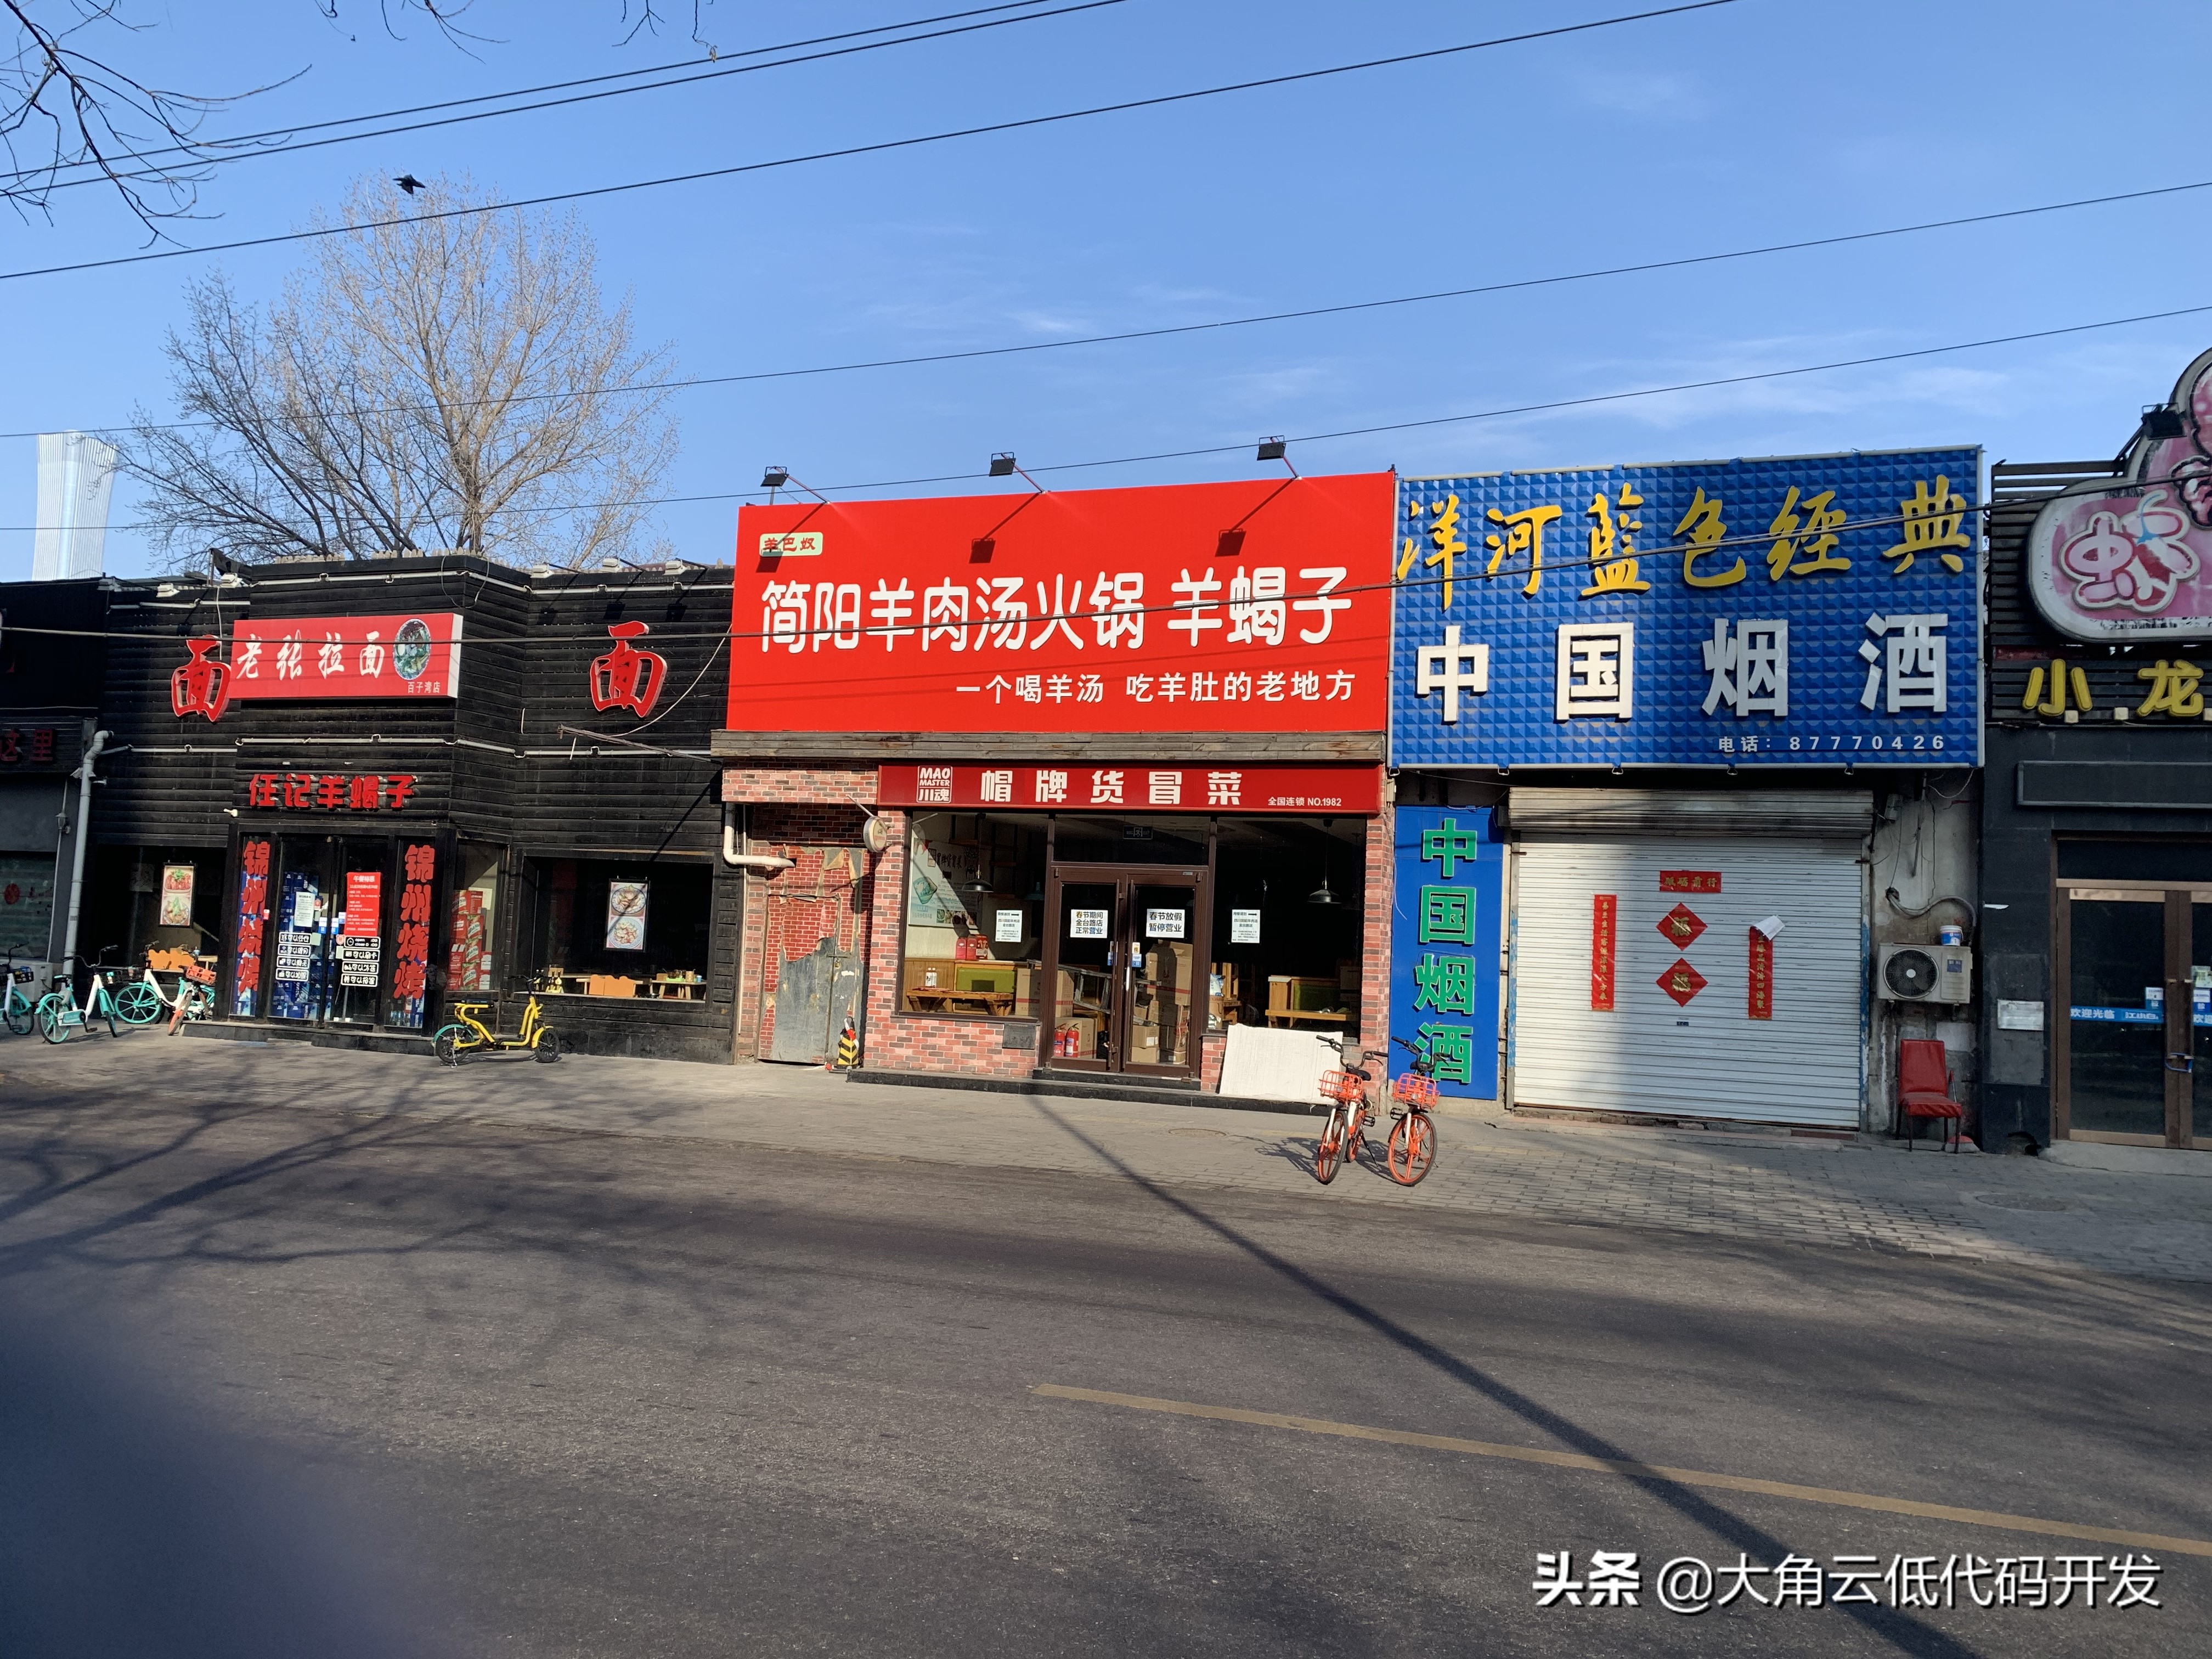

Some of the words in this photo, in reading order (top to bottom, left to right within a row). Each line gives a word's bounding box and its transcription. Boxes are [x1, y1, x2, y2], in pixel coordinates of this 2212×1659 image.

[760, 571, 1144, 654] 简阳羊肉汤火锅
[1167, 565, 1352, 647] 羊蝎子
[236, 629, 385, 681] 老张拉面
[1416, 612, 1948, 724] 中国烟酒
[407, 681, 441, 694] 百子湾店
[956, 673, 1104, 704] 一个喝羊汤
[1126, 669, 1356, 703] 吃羊肚的老地方
[2023, 658, 2204, 717] 小龙
[1790, 733, 1946, 751] 87770426
[249, 772, 419, 810] 任记羊蝎子
[919, 768, 951, 779] MAO
[980, 770, 1243, 806] 帽牌货冒菜
[918, 788, 950, 801] 川魂
[1268, 796, 1305, 807] 全国连锁
[1307, 797, 1342, 808] NO.1982
[241, 840, 270, 992] 锦州烧烤
[393, 844, 436, 1000] 锦州烧烤
[1149, 912, 1182, 921] 春节放假
[1149, 923, 1182, 933] 暂停营业
[1414, 817, 1478, 1085] 中国烟酒
[2070, 1008, 2115, 1019] 欢迎光临
